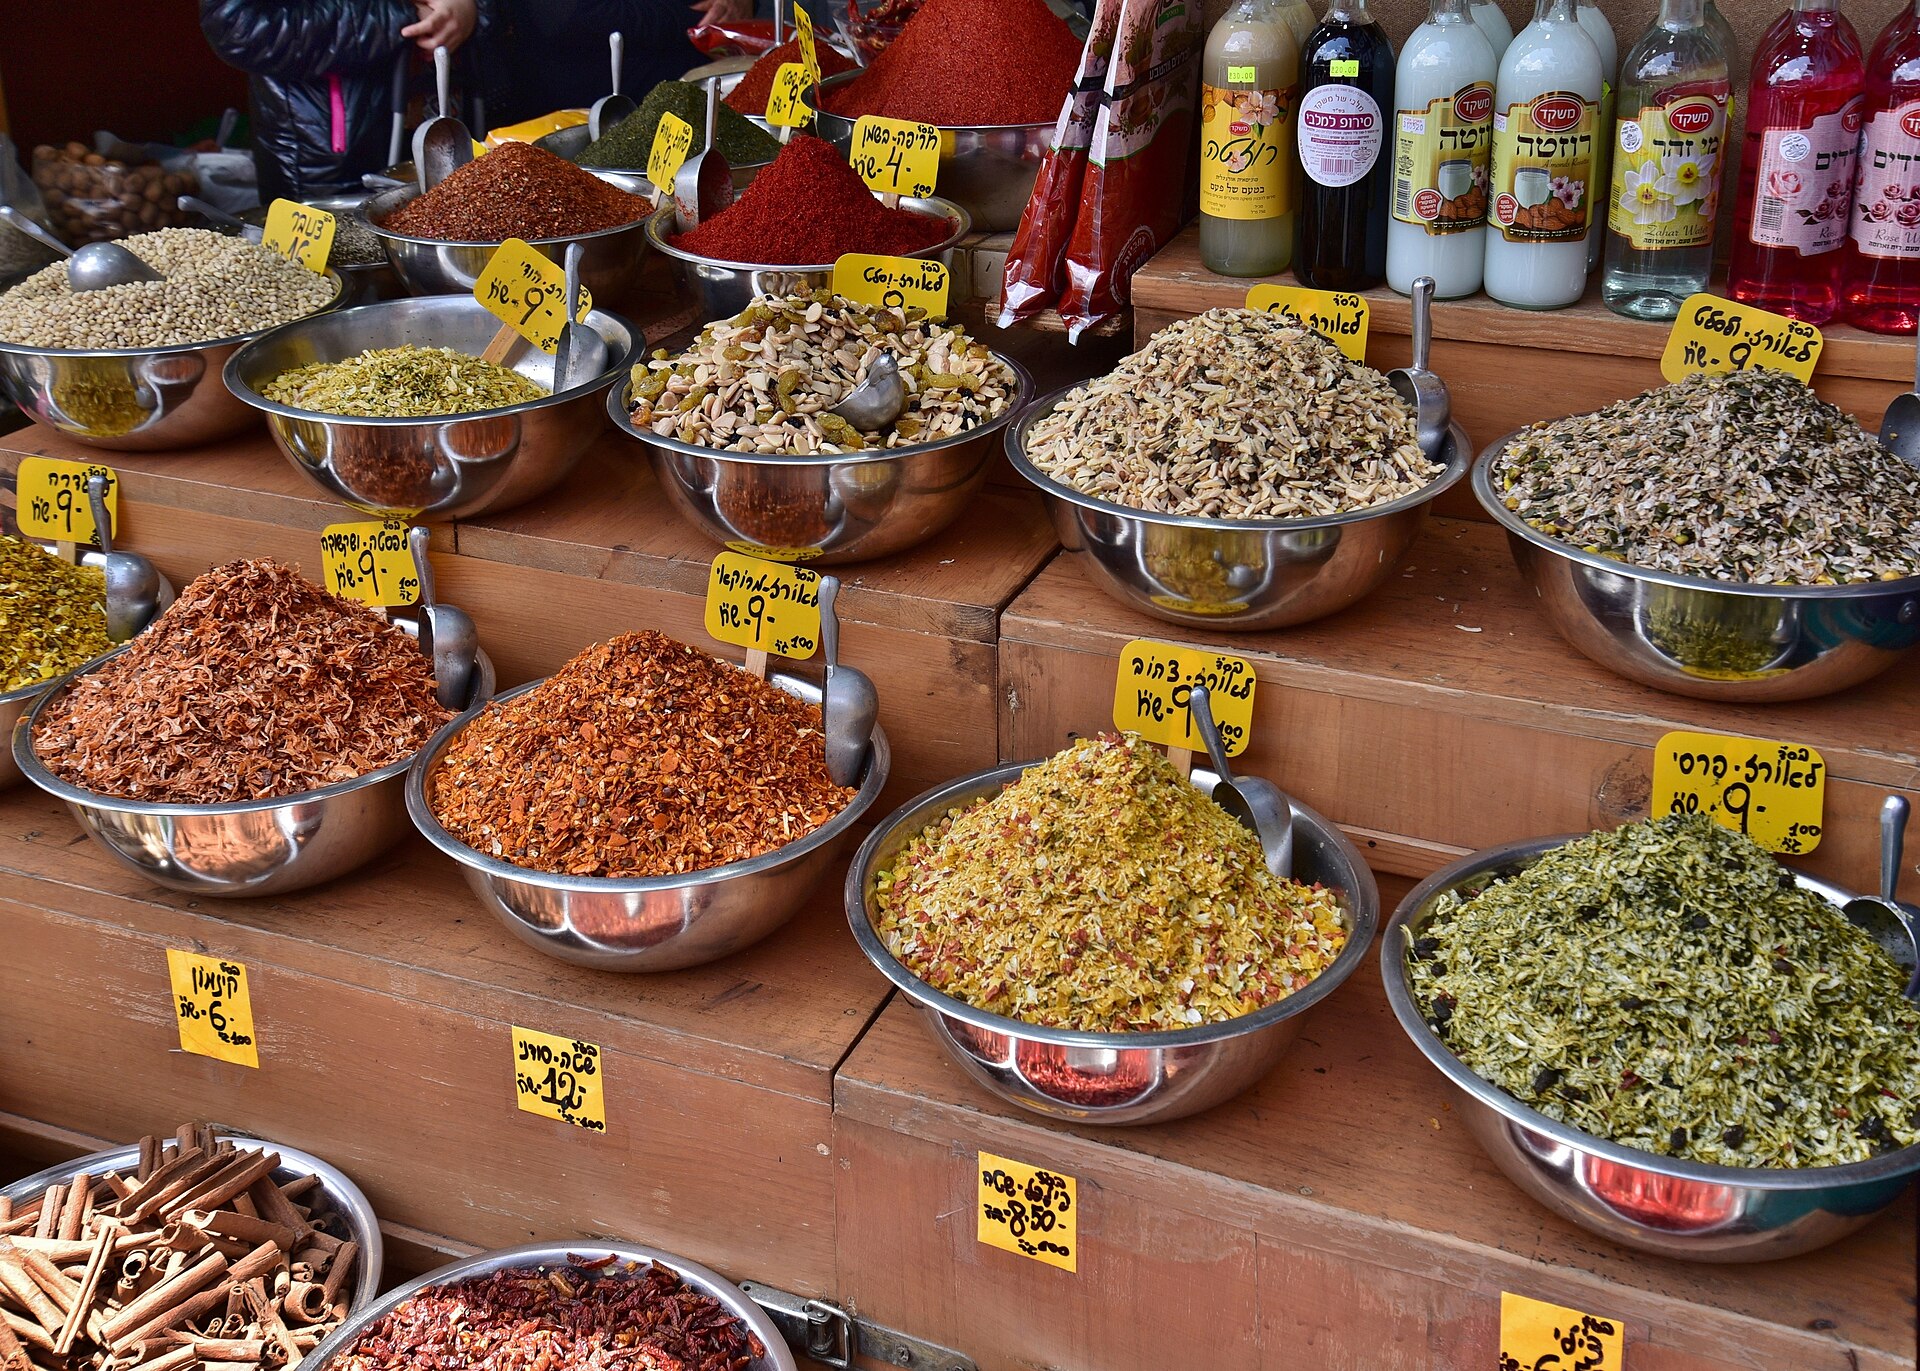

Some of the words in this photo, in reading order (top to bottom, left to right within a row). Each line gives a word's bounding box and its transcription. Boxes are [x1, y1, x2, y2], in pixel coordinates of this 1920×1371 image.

[1313, 95, 1334, 110] משקד
[1335, 94, 1347, 103] של
[1348, 98, 1365, 112] מלבי
[1463, 97, 1490, 114] משקד
[1306, 113, 1336, 127] למלבי
[1339, 116, 1372, 128] סירופ
[1540, 108, 1576, 123] משקד
[1675, 112, 1709, 128] משקד
[1231, 125, 1249, 133] משקד
[1439, 123, 1492, 150] וזטה
[1516, 134, 1591, 157] רוזטה
[1653, 138, 1694, 158] זהר
[1702, 136, 1719, 156] מי
[1206, 138, 1278, 173] רוזטה
[912, 183, 931, 194] 100
[1210, 183, 1224, 192] פעם
[1226, 183, 1239, 193] של
[1242, 187, 1265, 195] בטעם
[1644, 224, 1679, 236] Zahar
[1874, 229, 1900, 242] Rose
[399, 577, 418, 590] 100
[790, 635, 814, 650] 100
[1788, 822, 1822, 837] 100
